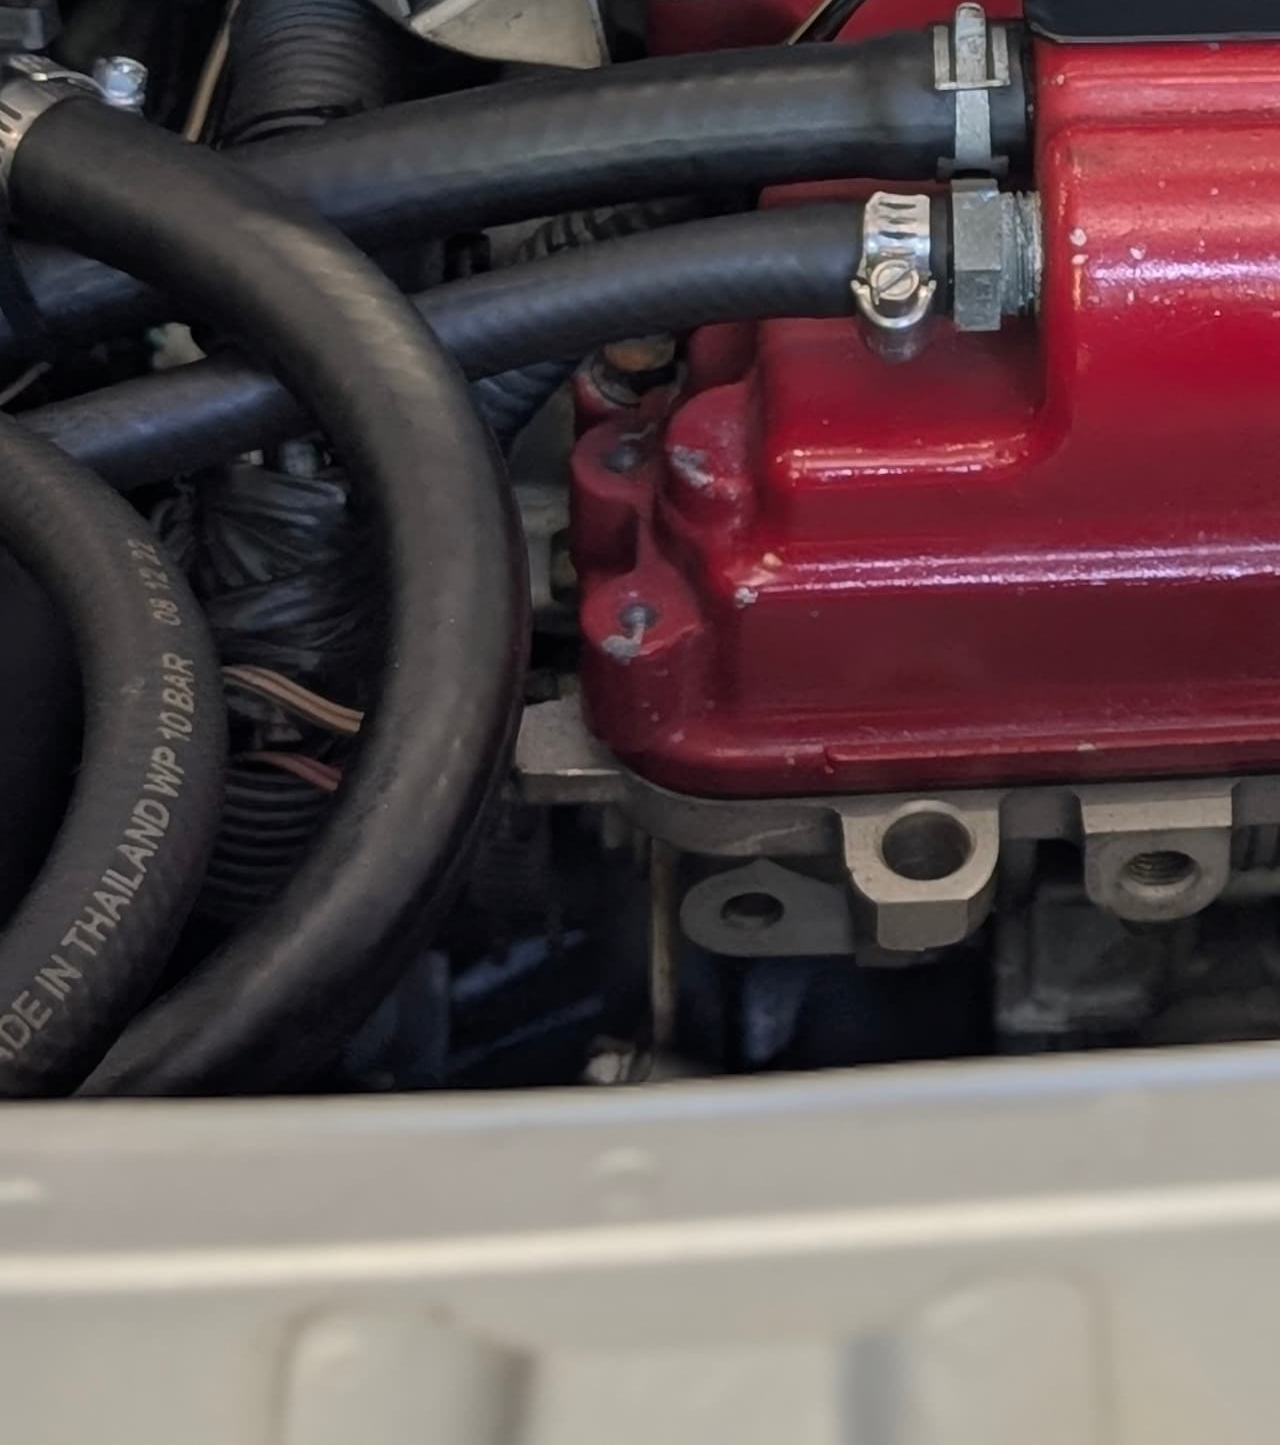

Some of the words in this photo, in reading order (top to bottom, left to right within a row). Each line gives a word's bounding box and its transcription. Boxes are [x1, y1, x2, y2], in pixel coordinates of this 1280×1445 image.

[164, 653, 196, 714] BAR
[160, 712, 194, 744] 10
[144, 746, 187, 814] WP
[60, 798, 170, 957] THAILAND
[33, 953, 83, 1002] IN
[0, 989, 53, 1060] DE
